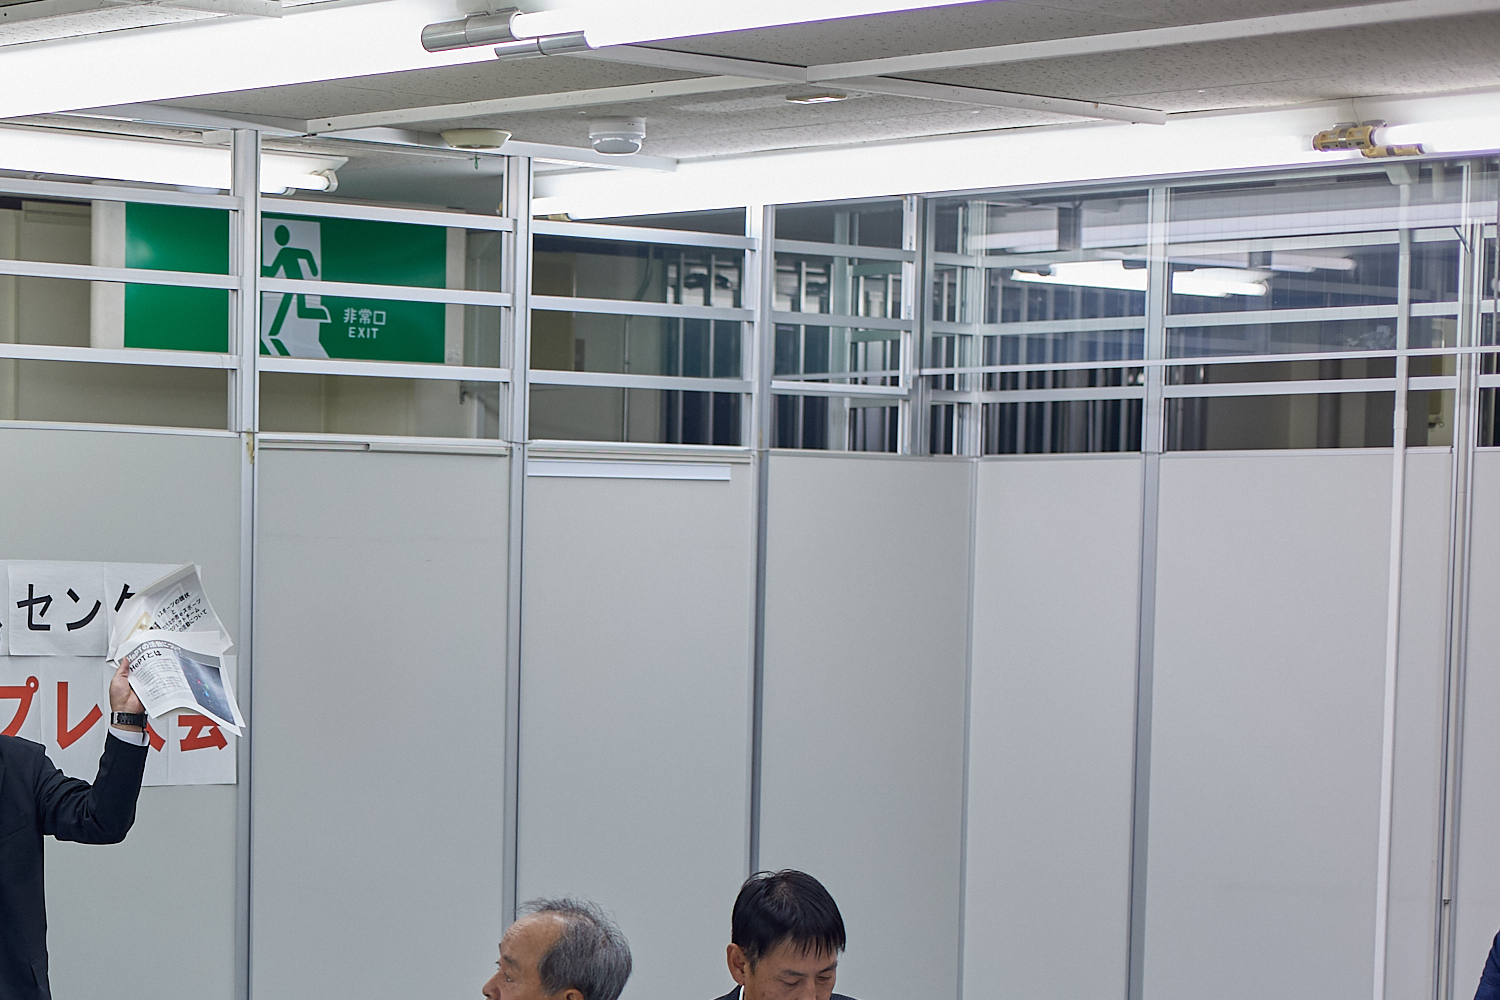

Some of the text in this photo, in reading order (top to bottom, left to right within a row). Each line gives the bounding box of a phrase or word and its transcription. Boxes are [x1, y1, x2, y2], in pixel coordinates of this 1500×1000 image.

[343, 307, 386, 325] 非常口
[348, 326, 379, 339] EXIT
[129, 650, 162, 672] HePTとは
